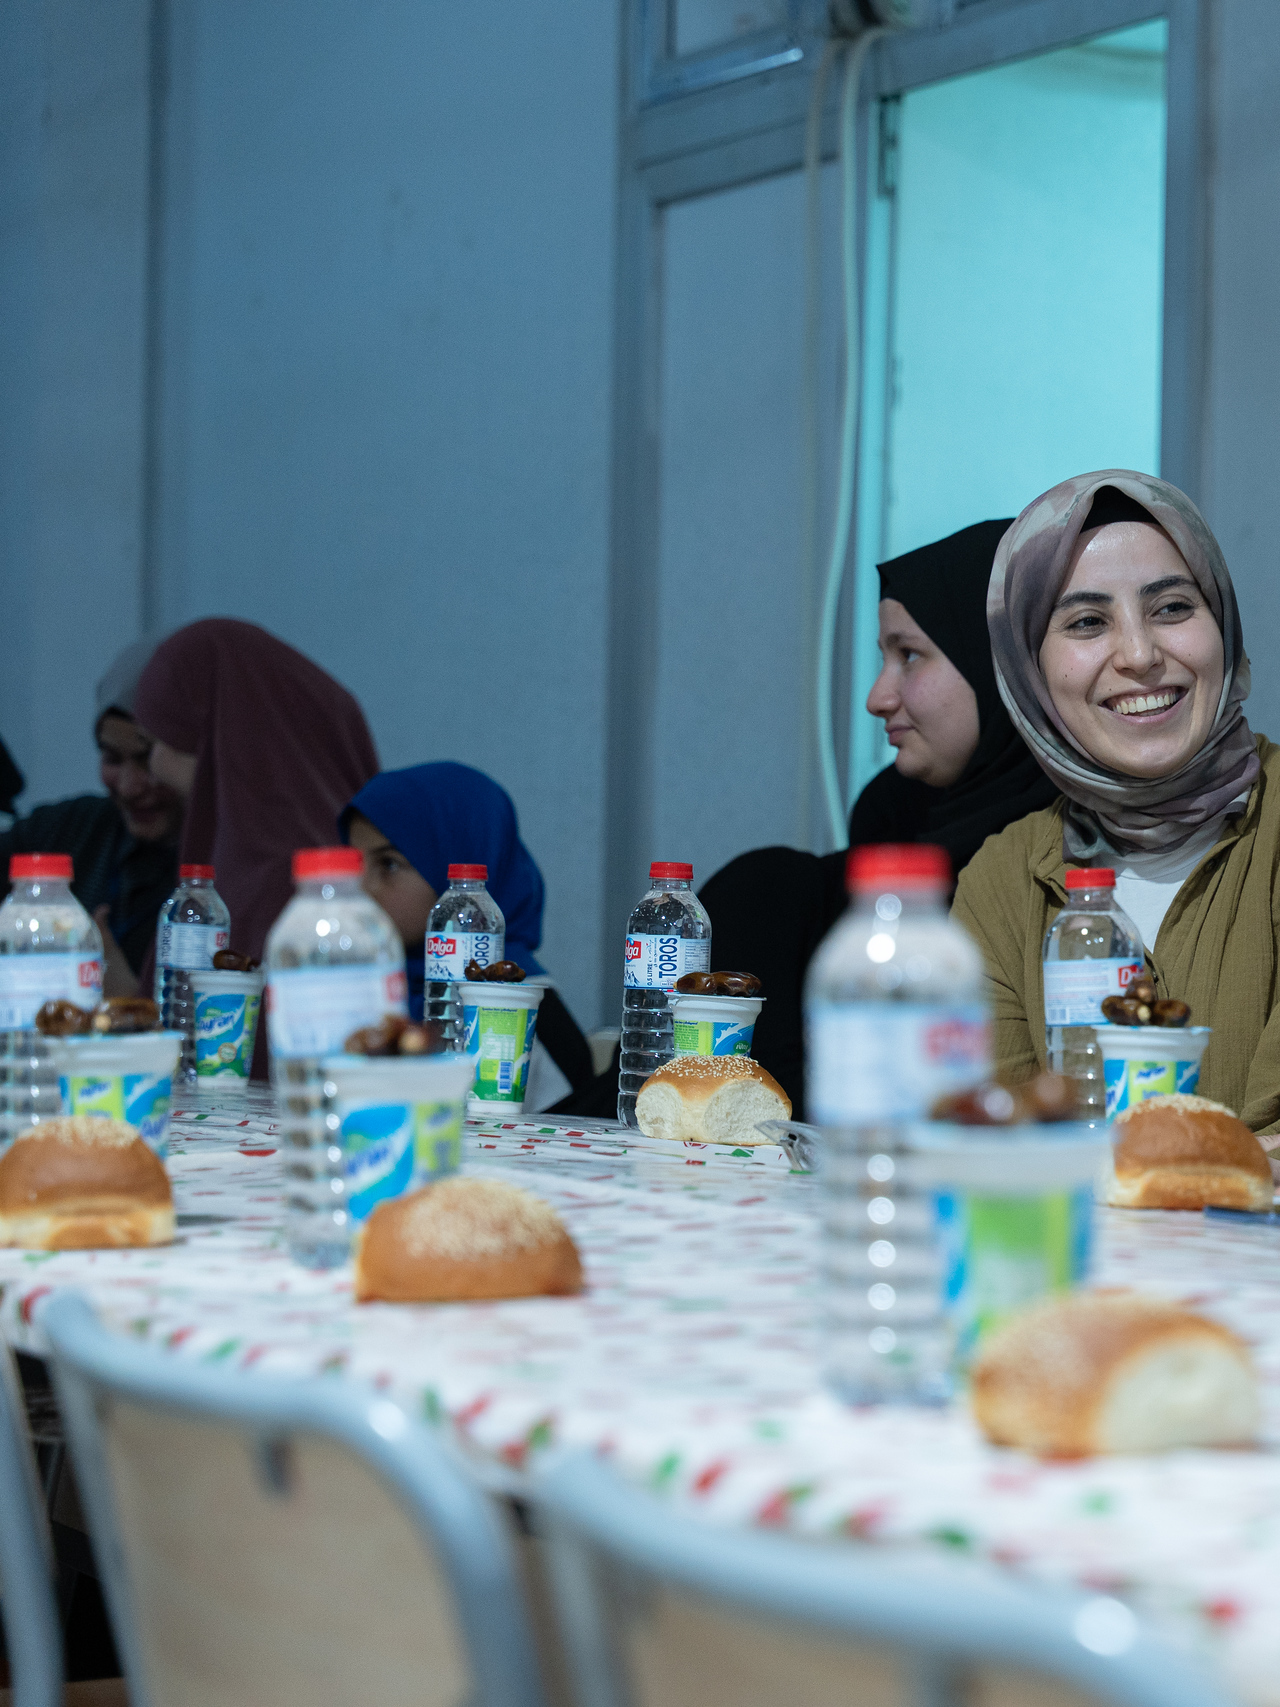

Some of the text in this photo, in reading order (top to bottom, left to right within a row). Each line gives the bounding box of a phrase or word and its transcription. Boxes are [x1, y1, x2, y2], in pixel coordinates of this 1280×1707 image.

[427, 938, 454, 956] Dalga
[474, 935, 489, 967] OROS
[658, 937, 678, 979] TOROS
